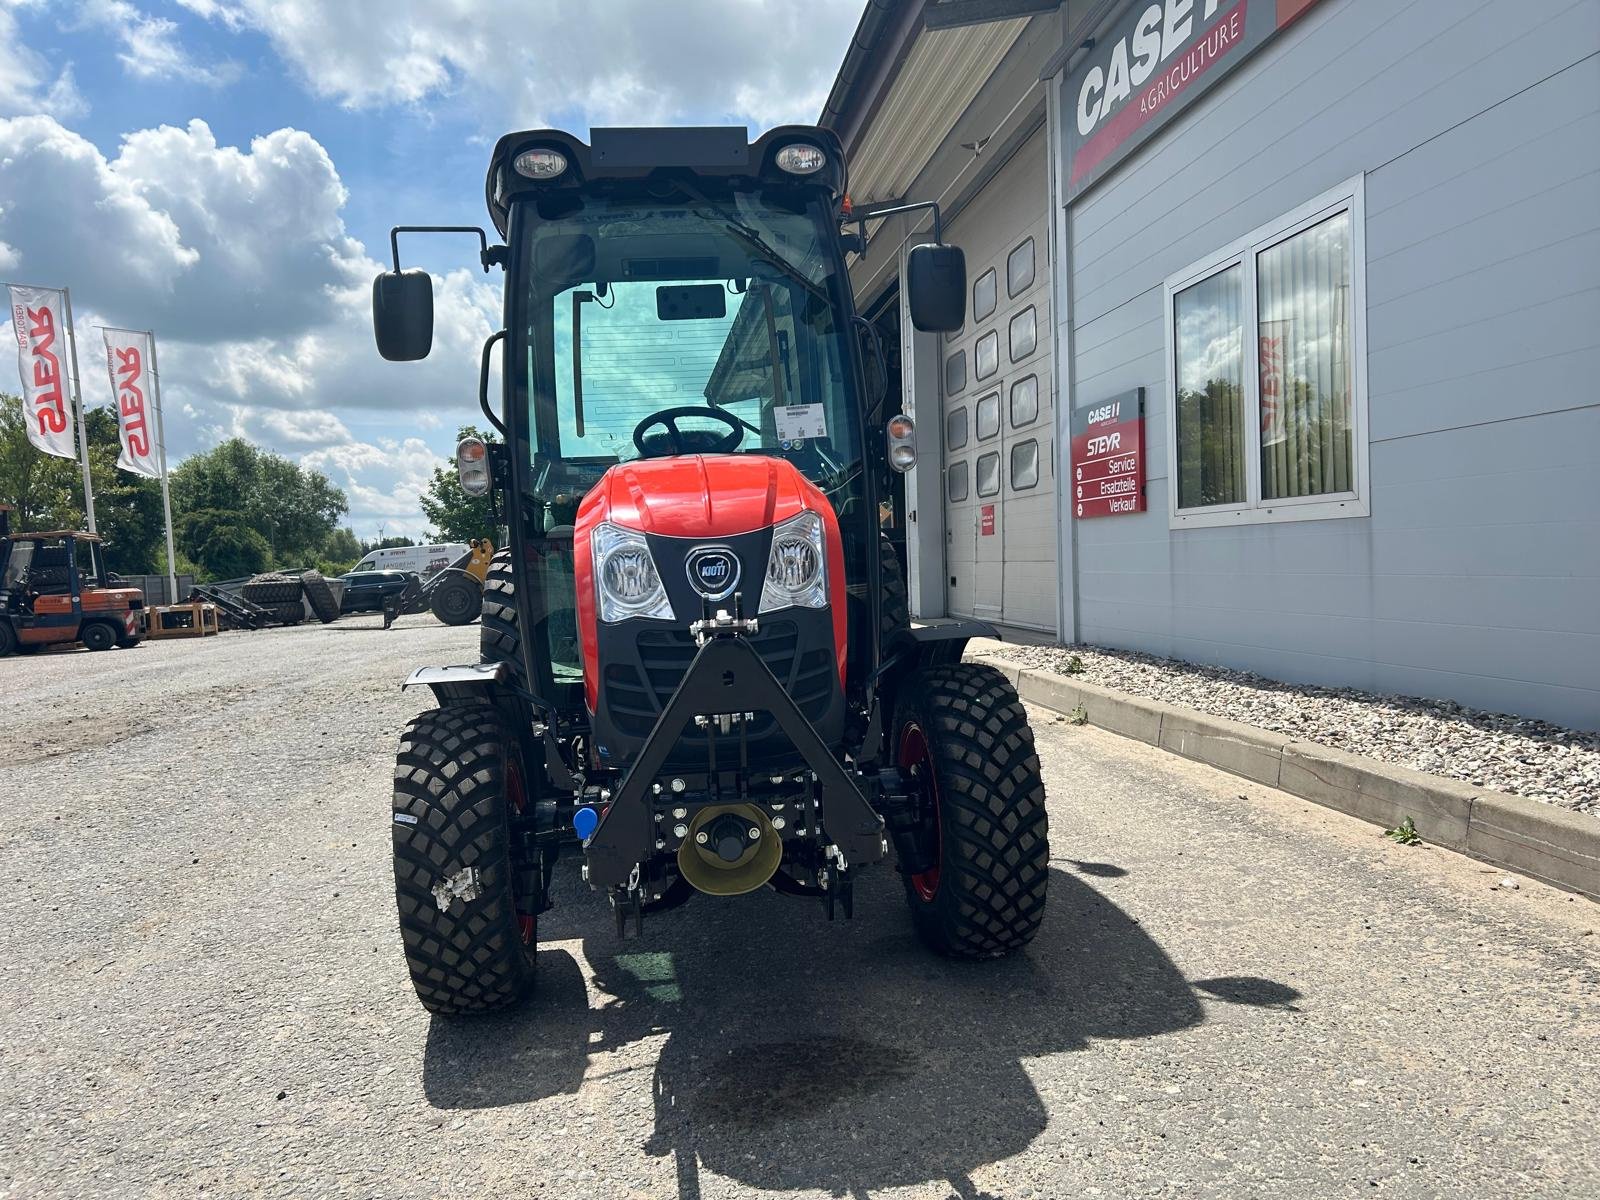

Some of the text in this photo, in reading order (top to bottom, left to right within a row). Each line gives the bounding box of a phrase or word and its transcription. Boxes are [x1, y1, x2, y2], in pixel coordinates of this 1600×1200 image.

[1077, 0, 1193, 136] CASE
[1139, 11, 1239, 118] AGRICULTURE
[1087, 432, 1120, 456] STEYR
[1109, 458, 1135, 474] Service
[1100, 478, 1135, 495] Ersatzteile
[1109, 496, 1136, 512] Verkauf
[702, 564, 725, 577] KIOTI
